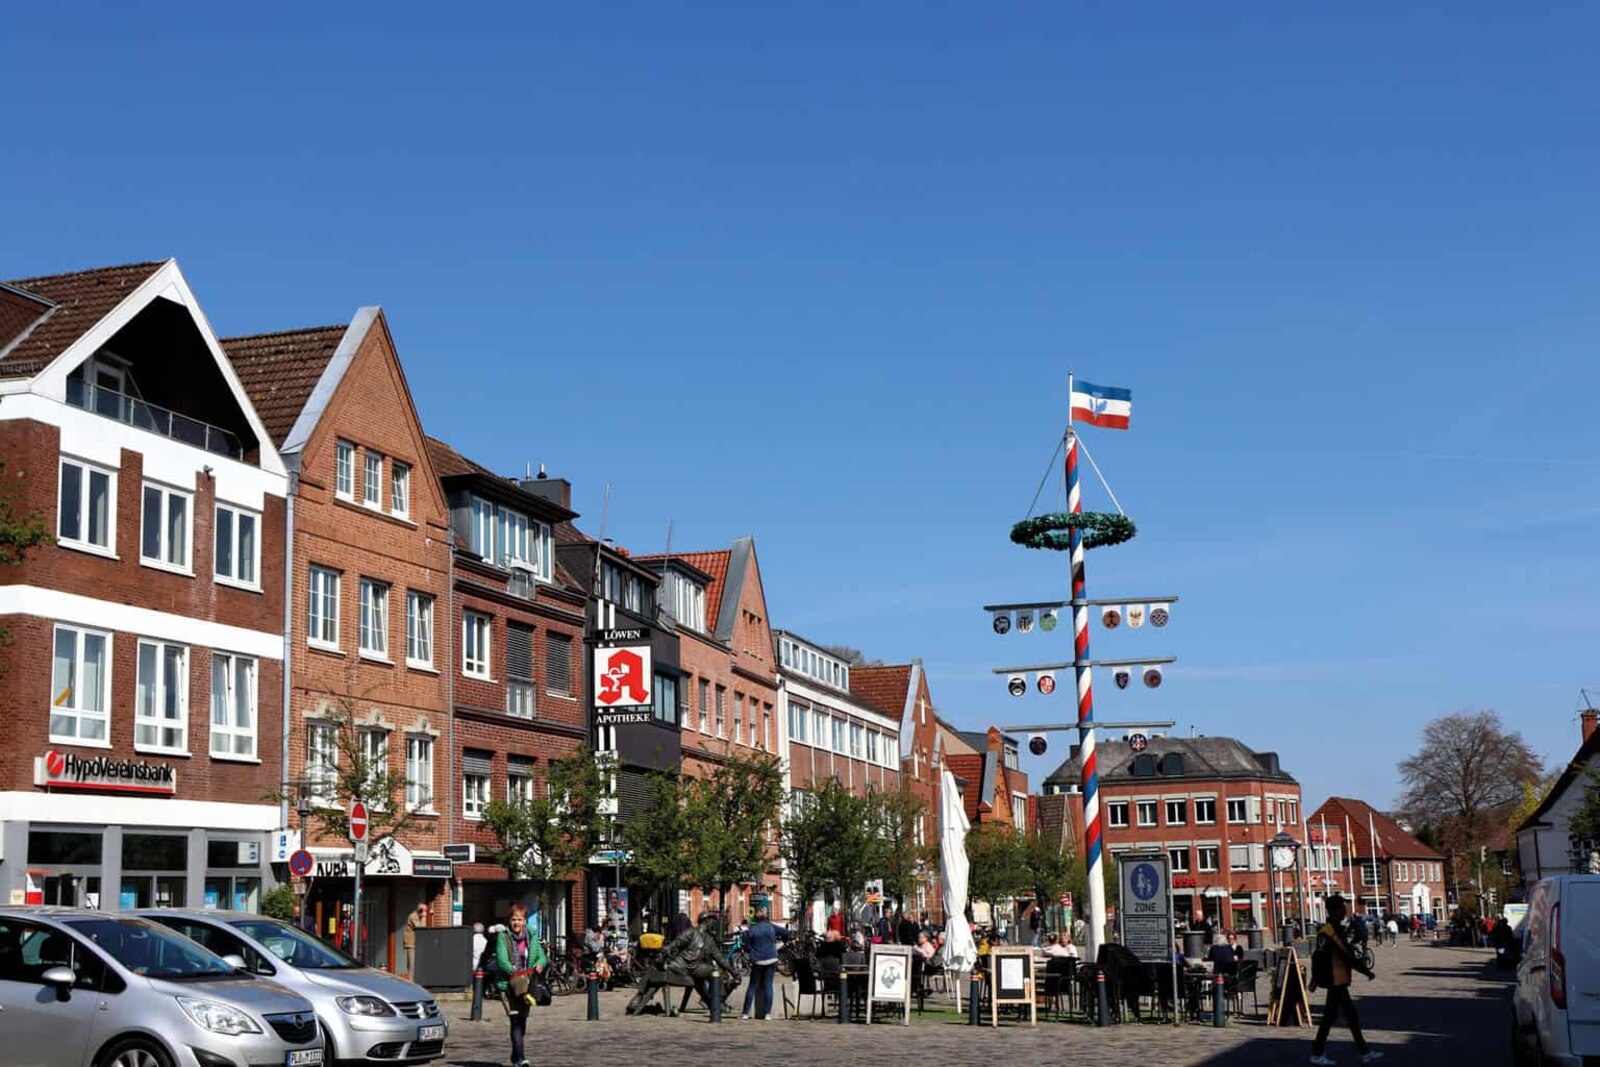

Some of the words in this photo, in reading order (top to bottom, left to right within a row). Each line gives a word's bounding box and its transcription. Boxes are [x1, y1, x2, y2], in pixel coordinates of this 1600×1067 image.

[604, 629, 641, 640] LÖWEN
[596, 713, 651, 724] APOTHEKE
[65, 754, 173, 782] HypoVereinsbank
[1134, 902, 1158, 913] ZONE
